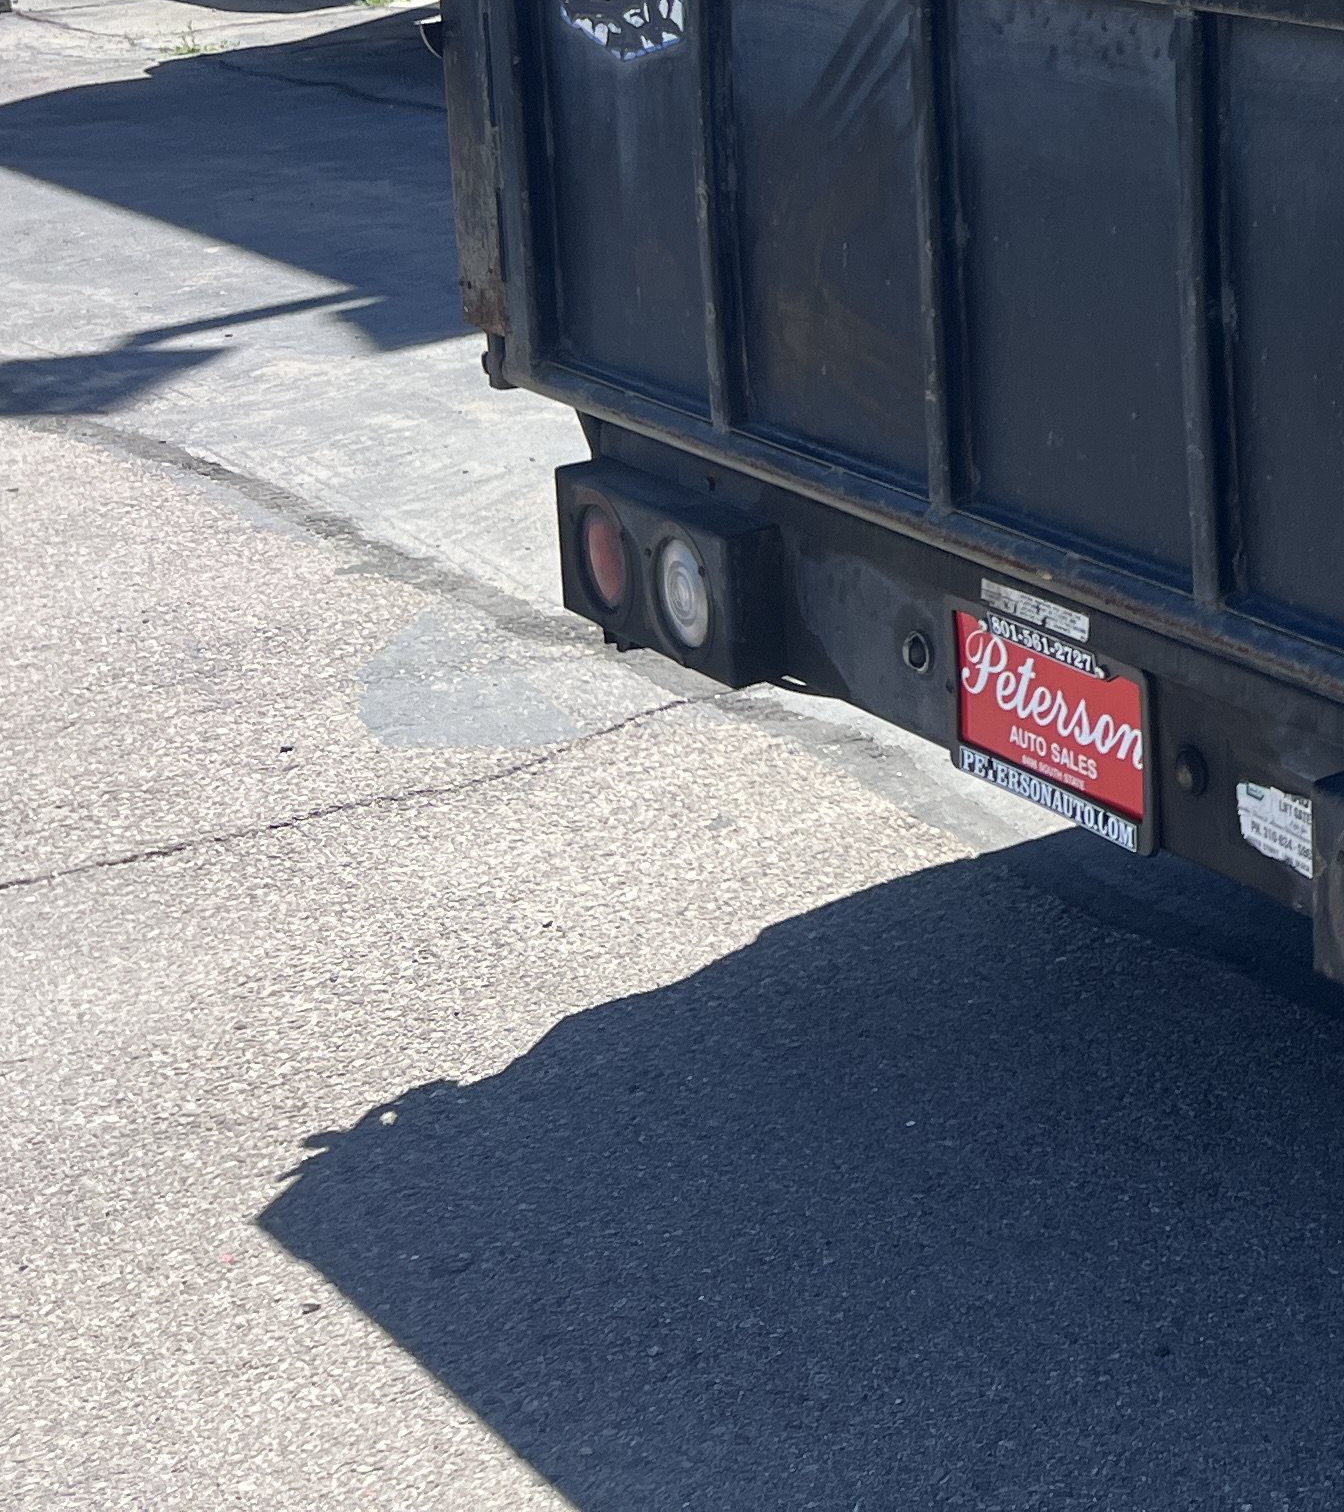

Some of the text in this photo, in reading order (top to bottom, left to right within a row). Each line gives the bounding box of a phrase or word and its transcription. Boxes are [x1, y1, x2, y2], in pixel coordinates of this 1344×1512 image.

[960, 628, 1144, 769] Peterson
[1009, 725, 1047, 757] AUTO
[1050, 742, 1098, 780] SALES
